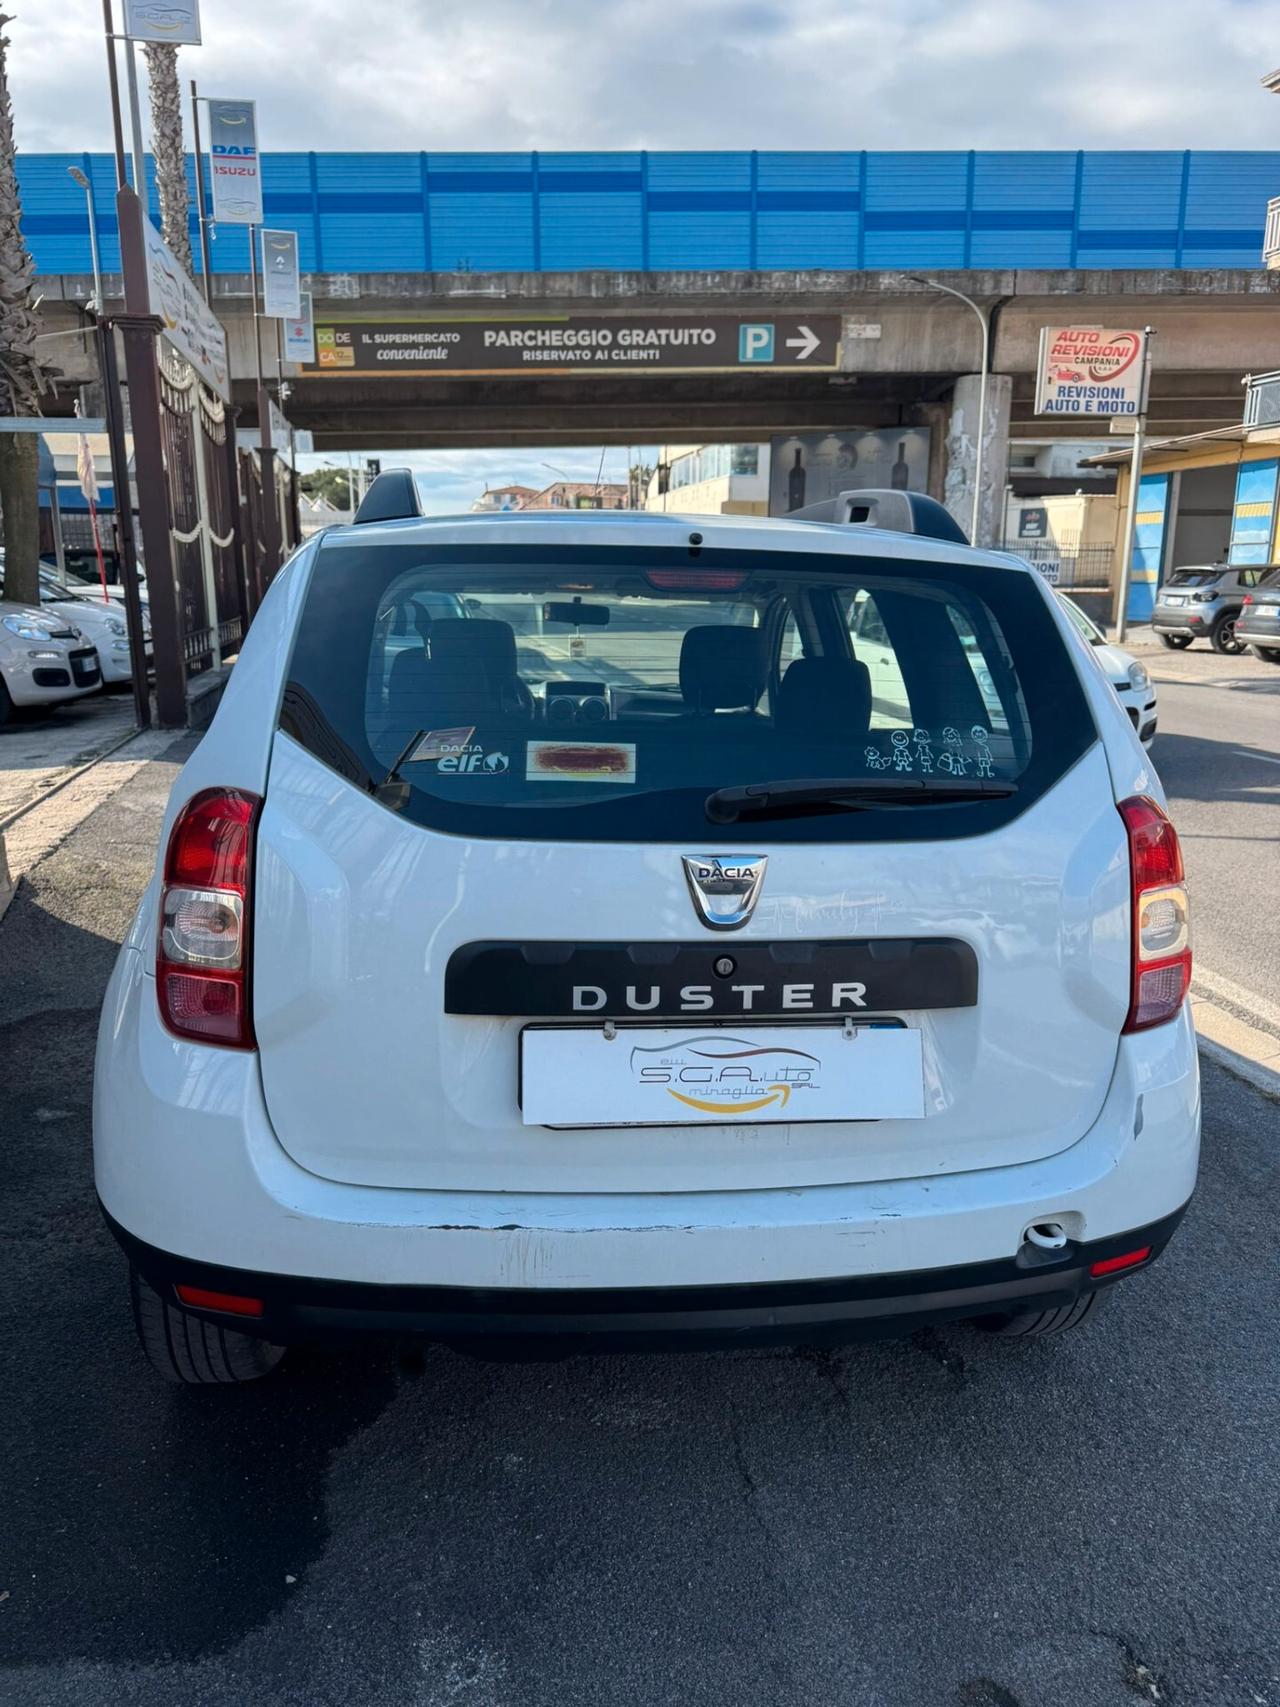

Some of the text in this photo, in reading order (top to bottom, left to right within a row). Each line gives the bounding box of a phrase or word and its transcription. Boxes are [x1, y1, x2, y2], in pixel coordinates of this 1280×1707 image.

[212, 145, 256, 155] DAF
[214, 166, 256, 176] ISUZU
[362, 333, 460, 343] IL SUPERMERCATO
[484, 328, 716, 347] PARCHEGGIO GRATUITO
[746, 328, 769, 358] P
[1056, 331, 1100, 343] AUTO
[376, 346, 448, 360] conveniente
[523, 349, 660, 361] RISERVATO AI CLIENTI
[1051, 344, 1130, 357] REVISIONI
[1074, 356, 1120, 366] CAMPANIA
[1057, 386, 1125, 399] REVISIONI
[1045, 399, 1135, 413] AUTO E MOTO
[439, 744, 483, 753] DACIA
[437, 754, 483, 772] elf
[699, 868, 755, 878] DACIA
[572, 982, 867, 1011] DUSTER
